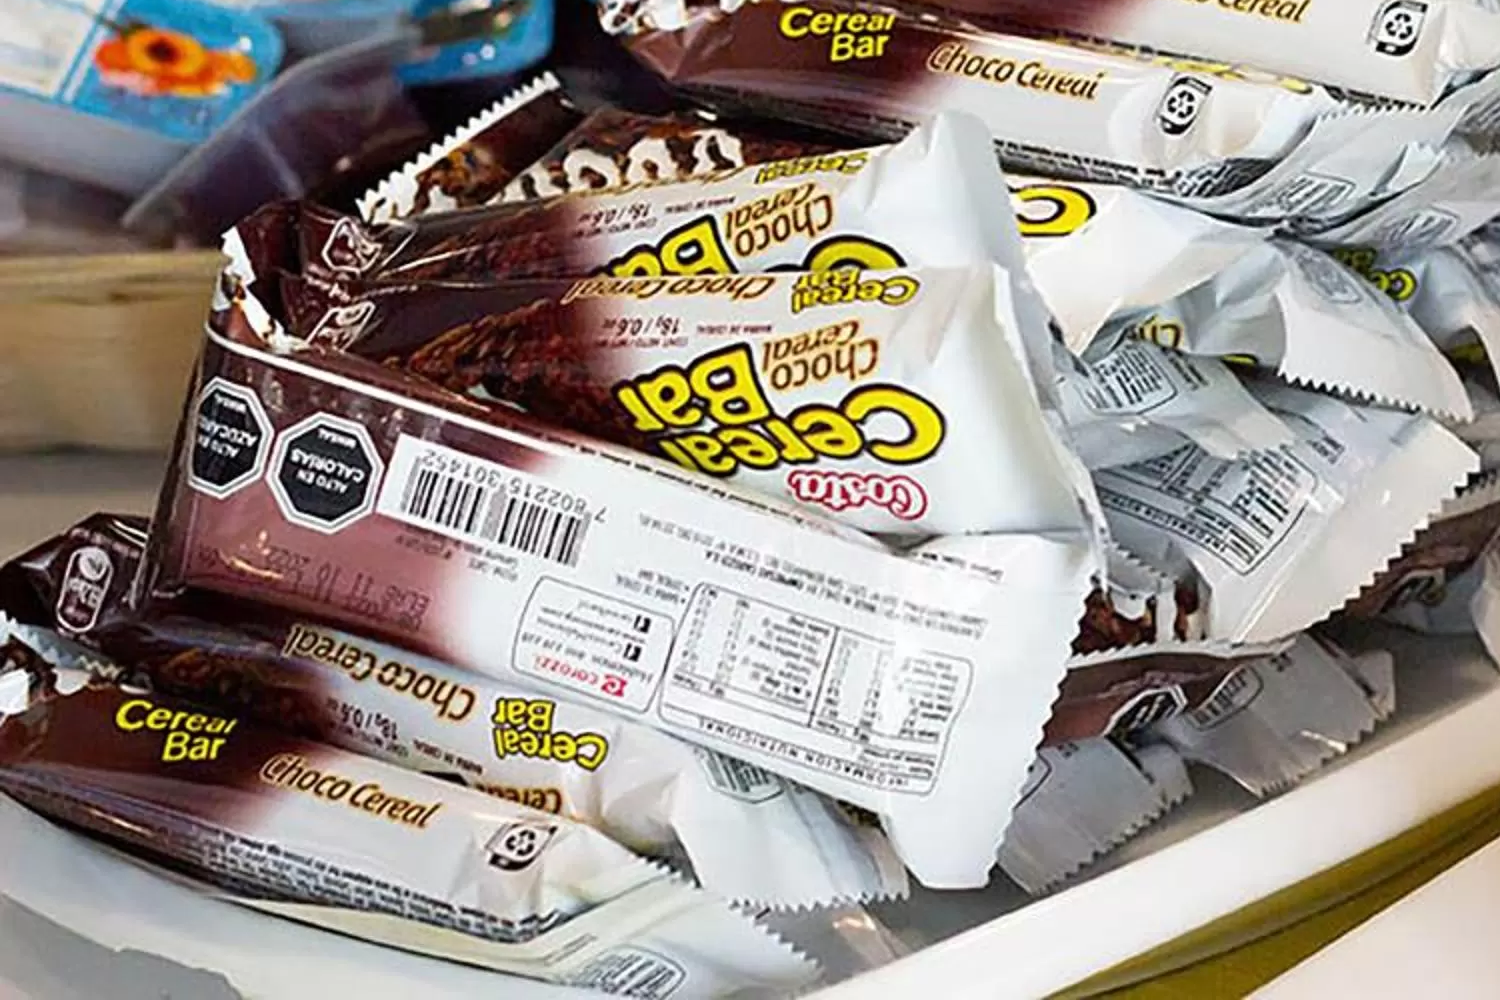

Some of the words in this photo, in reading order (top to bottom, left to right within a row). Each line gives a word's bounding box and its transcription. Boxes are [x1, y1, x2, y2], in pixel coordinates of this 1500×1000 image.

[779, 7, 895, 38] Cereal
[830, 32, 891, 63] Bar
[926, 41, 1014, 84] Choco
[1016, 56, 1104, 102] Cereal
[724, 183, 817, 241] Cereal
[735, 190, 834, 258] Choco
[560, 275, 664, 305] Cereal
[670, 276, 776, 300] Choco
[791, 276, 921, 313] Cereal
[763, 319, 860, 368] Cereal
[769, 338, 878, 391] Choco
[613, 340, 771, 437] Bar
[658, 381, 946, 478] Cereal
[289, 447, 366, 481] CALORÍAS
[294, 467, 316, 483] EN
[314, 473, 349, 494] ALTO
[418, 447, 503, 489] 301452
[506, 475, 589, 517] 802215
[593, 504, 607, 522] 7
[787, 467, 927, 520] Costa
[284, 624, 378, 681] Cereal
[377, 665, 477, 723] Choco
[115, 700, 237, 737] Cereal
[492, 699, 555, 733] Bar
[162, 731, 228, 763] Bar
[493, 728, 609, 770] Cereal
[260, 753, 352, 800] Choco
[351, 783, 443, 831] Cereal
